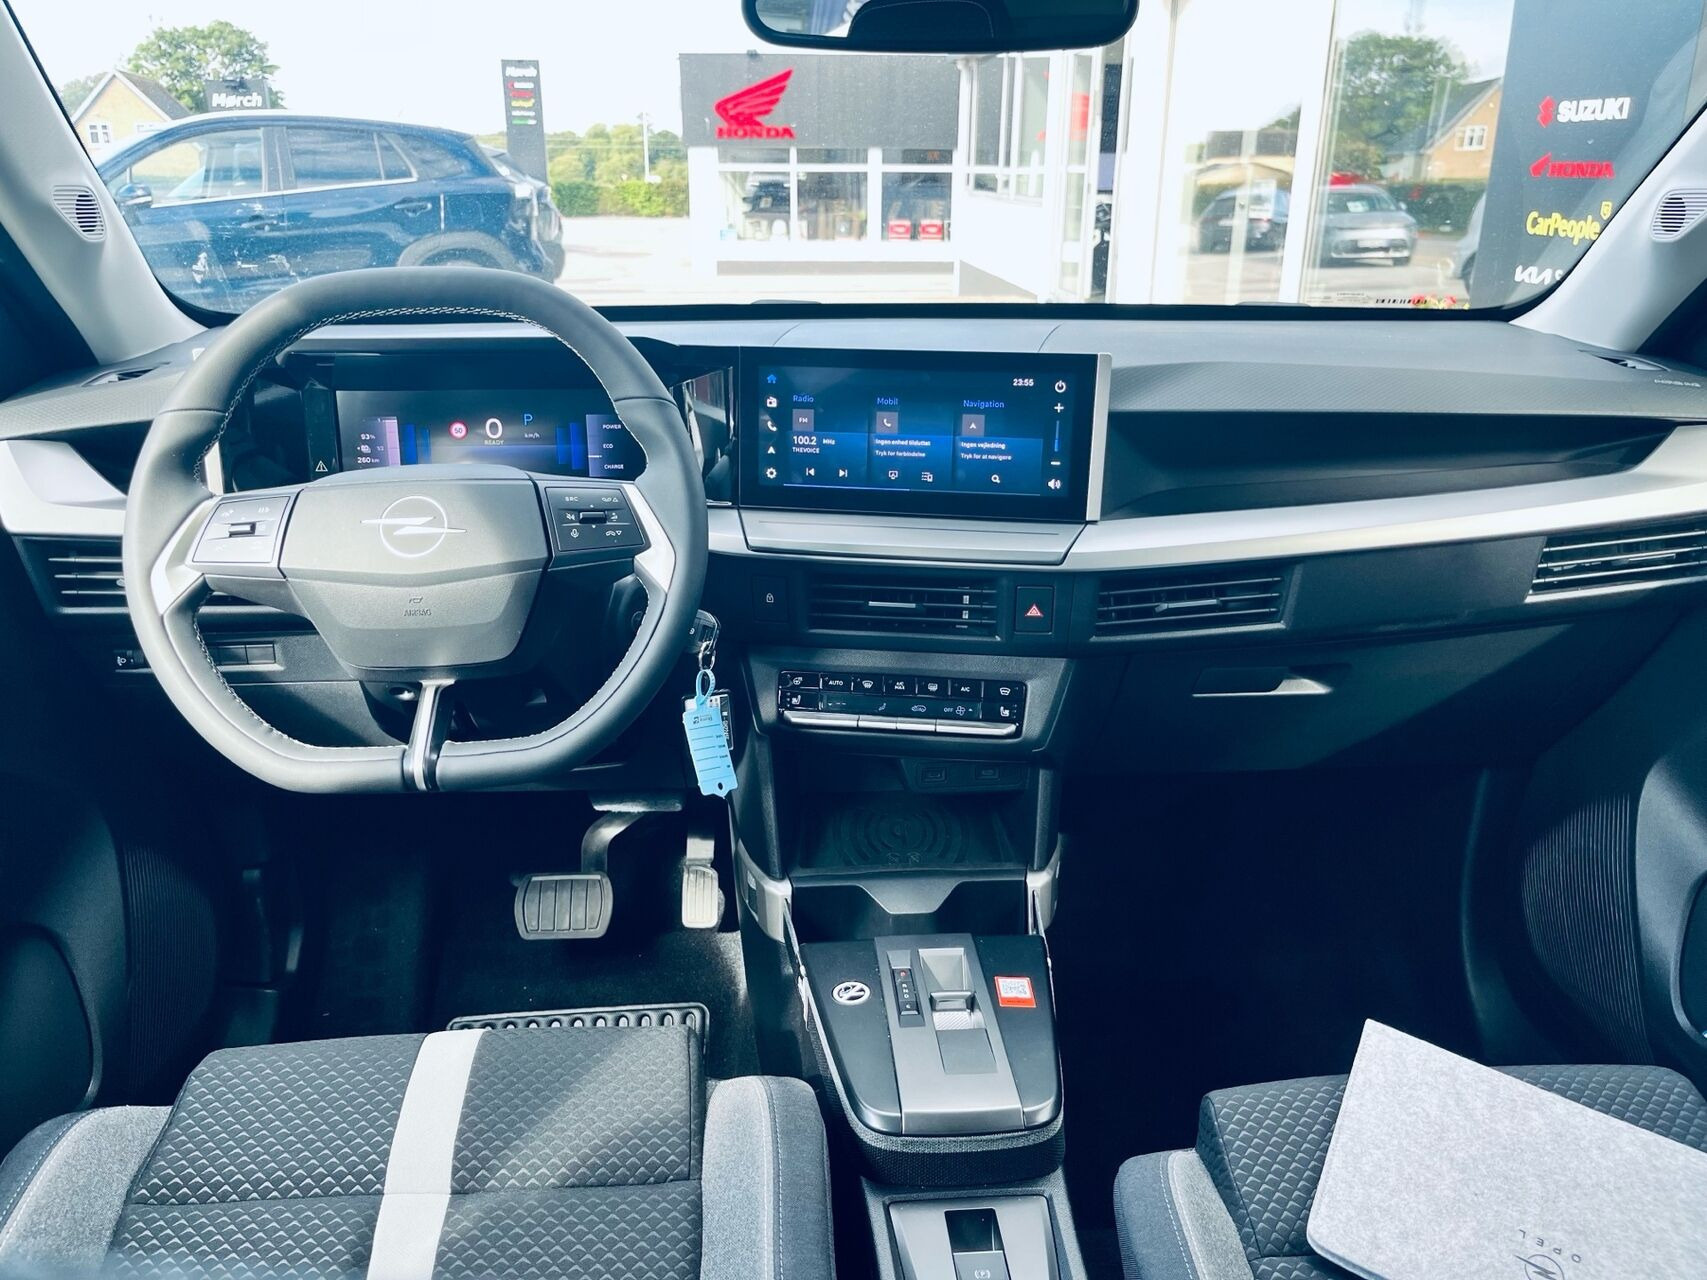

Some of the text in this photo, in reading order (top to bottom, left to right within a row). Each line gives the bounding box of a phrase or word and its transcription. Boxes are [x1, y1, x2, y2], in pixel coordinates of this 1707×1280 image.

[1556, 97, 1631, 123] SUZUKI
[716, 125, 795, 139] HONDA
[1547, 161, 1616, 179] HONDA
[1526, 210, 1600, 246] CarPeople
[1012, 378, 1035, 387] 23:55
[793, 394, 814, 403] Radio
[877, 397, 899, 406] Mobil
[963, 399, 1005, 410] Navigation
[523, 413, 533, 426] P
[485, 418, 503, 439] 0
[792, 435, 817, 446] 100.2
